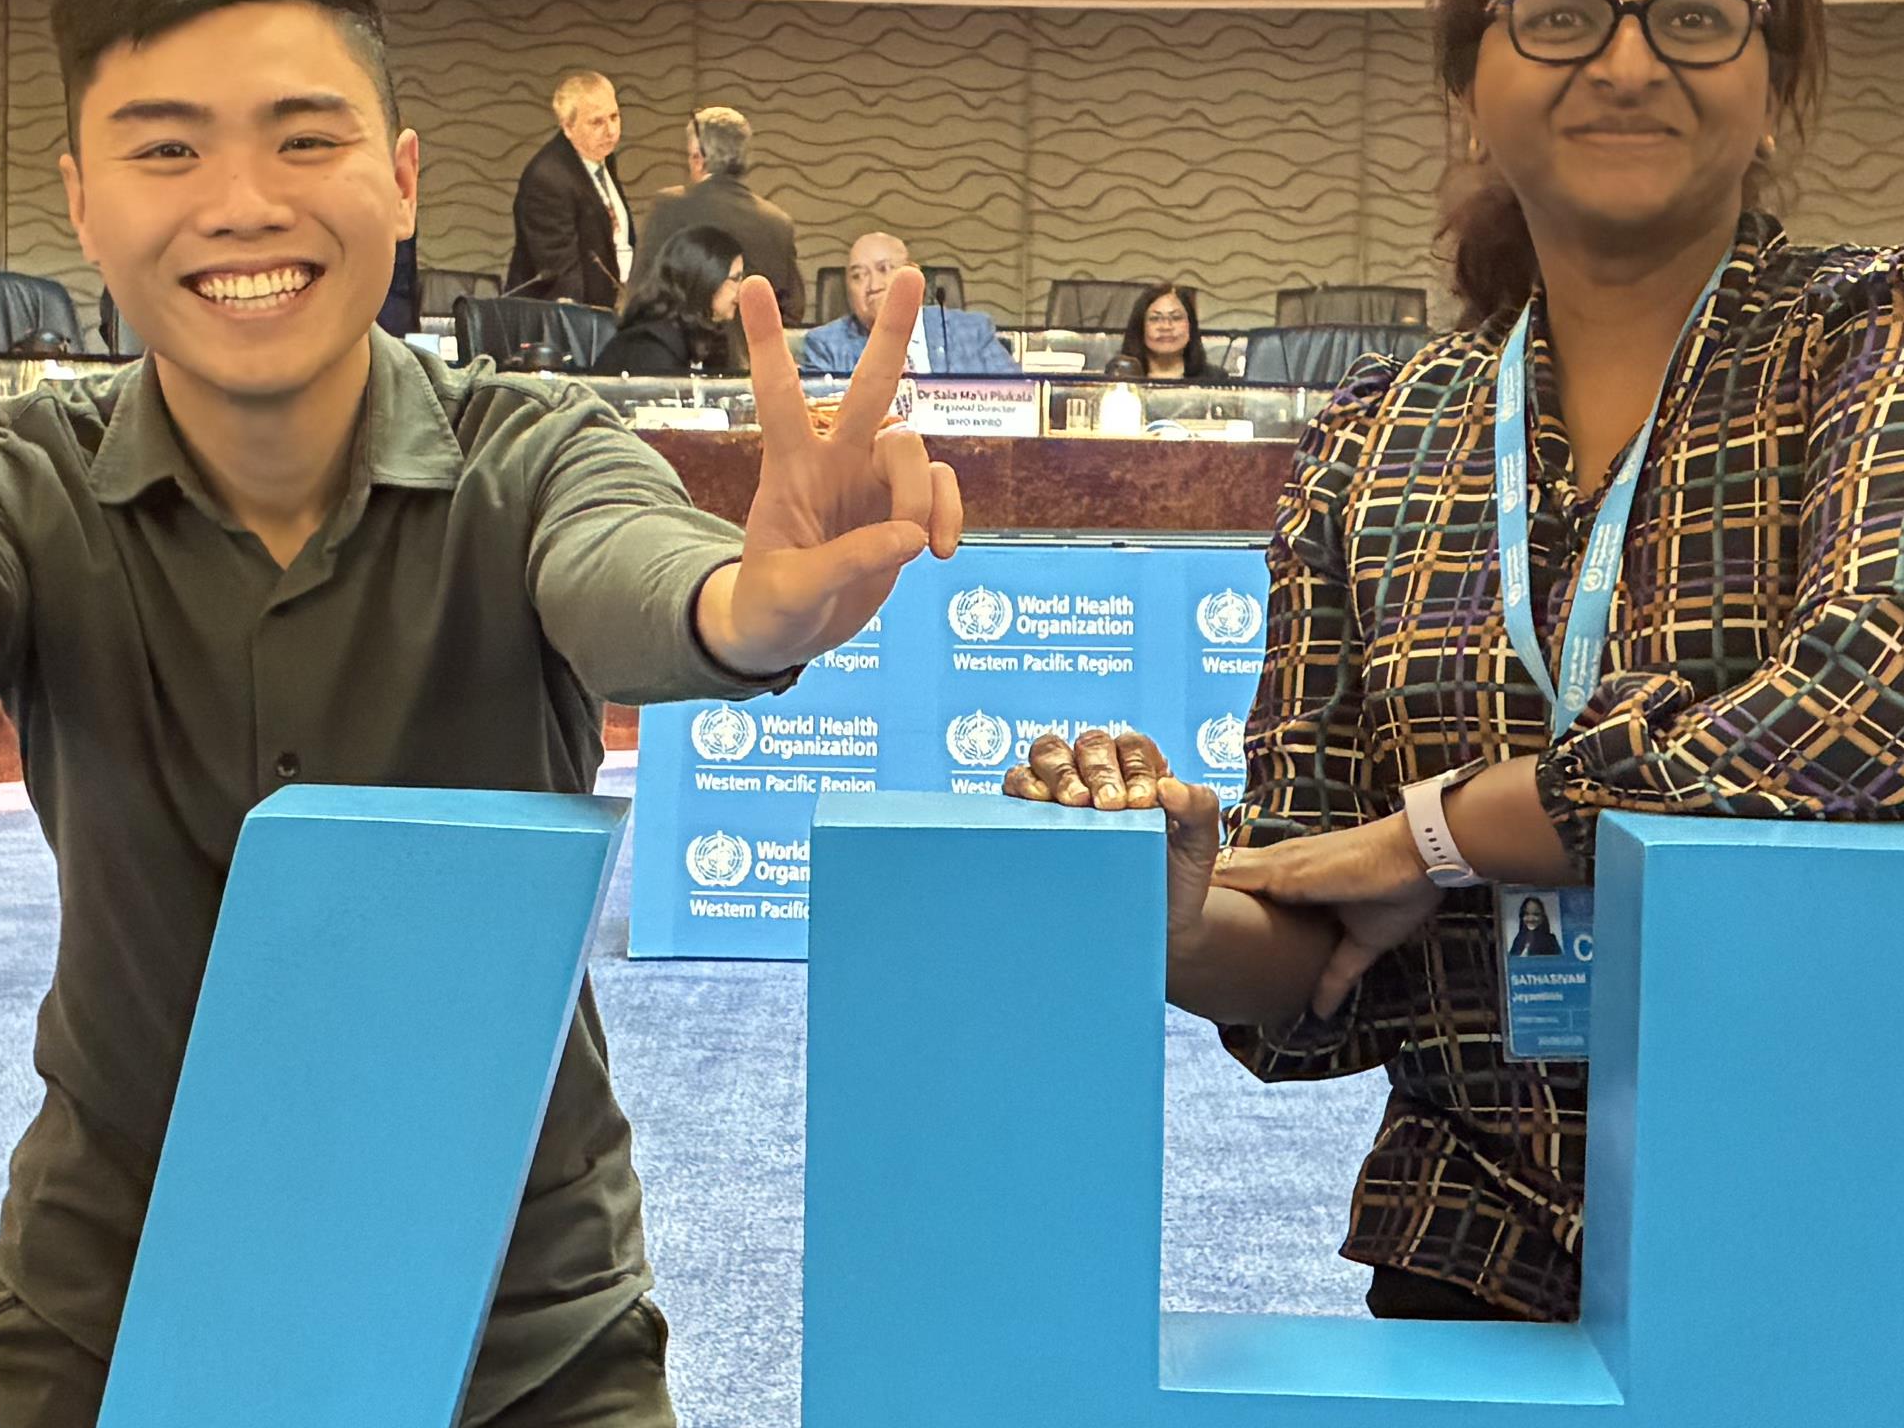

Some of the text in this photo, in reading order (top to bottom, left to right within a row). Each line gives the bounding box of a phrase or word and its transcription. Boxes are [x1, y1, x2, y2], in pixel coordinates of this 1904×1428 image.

[1016, 595, 1134, 615] World Health
[1016, 615, 1134, 639] Organization
[824, 651, 879, 672] Region
[953, 653, 1134, 676] Western Pacific Region
[760, 715, 878, 736] World Health
[759, 735, 878, 759] Organization
[695, 773, 761, 791] Western
[765, 774, 816, 793] Pacific
[756, 840, 810, 861] World
[689, 899, 809, 920] Western Pacific
